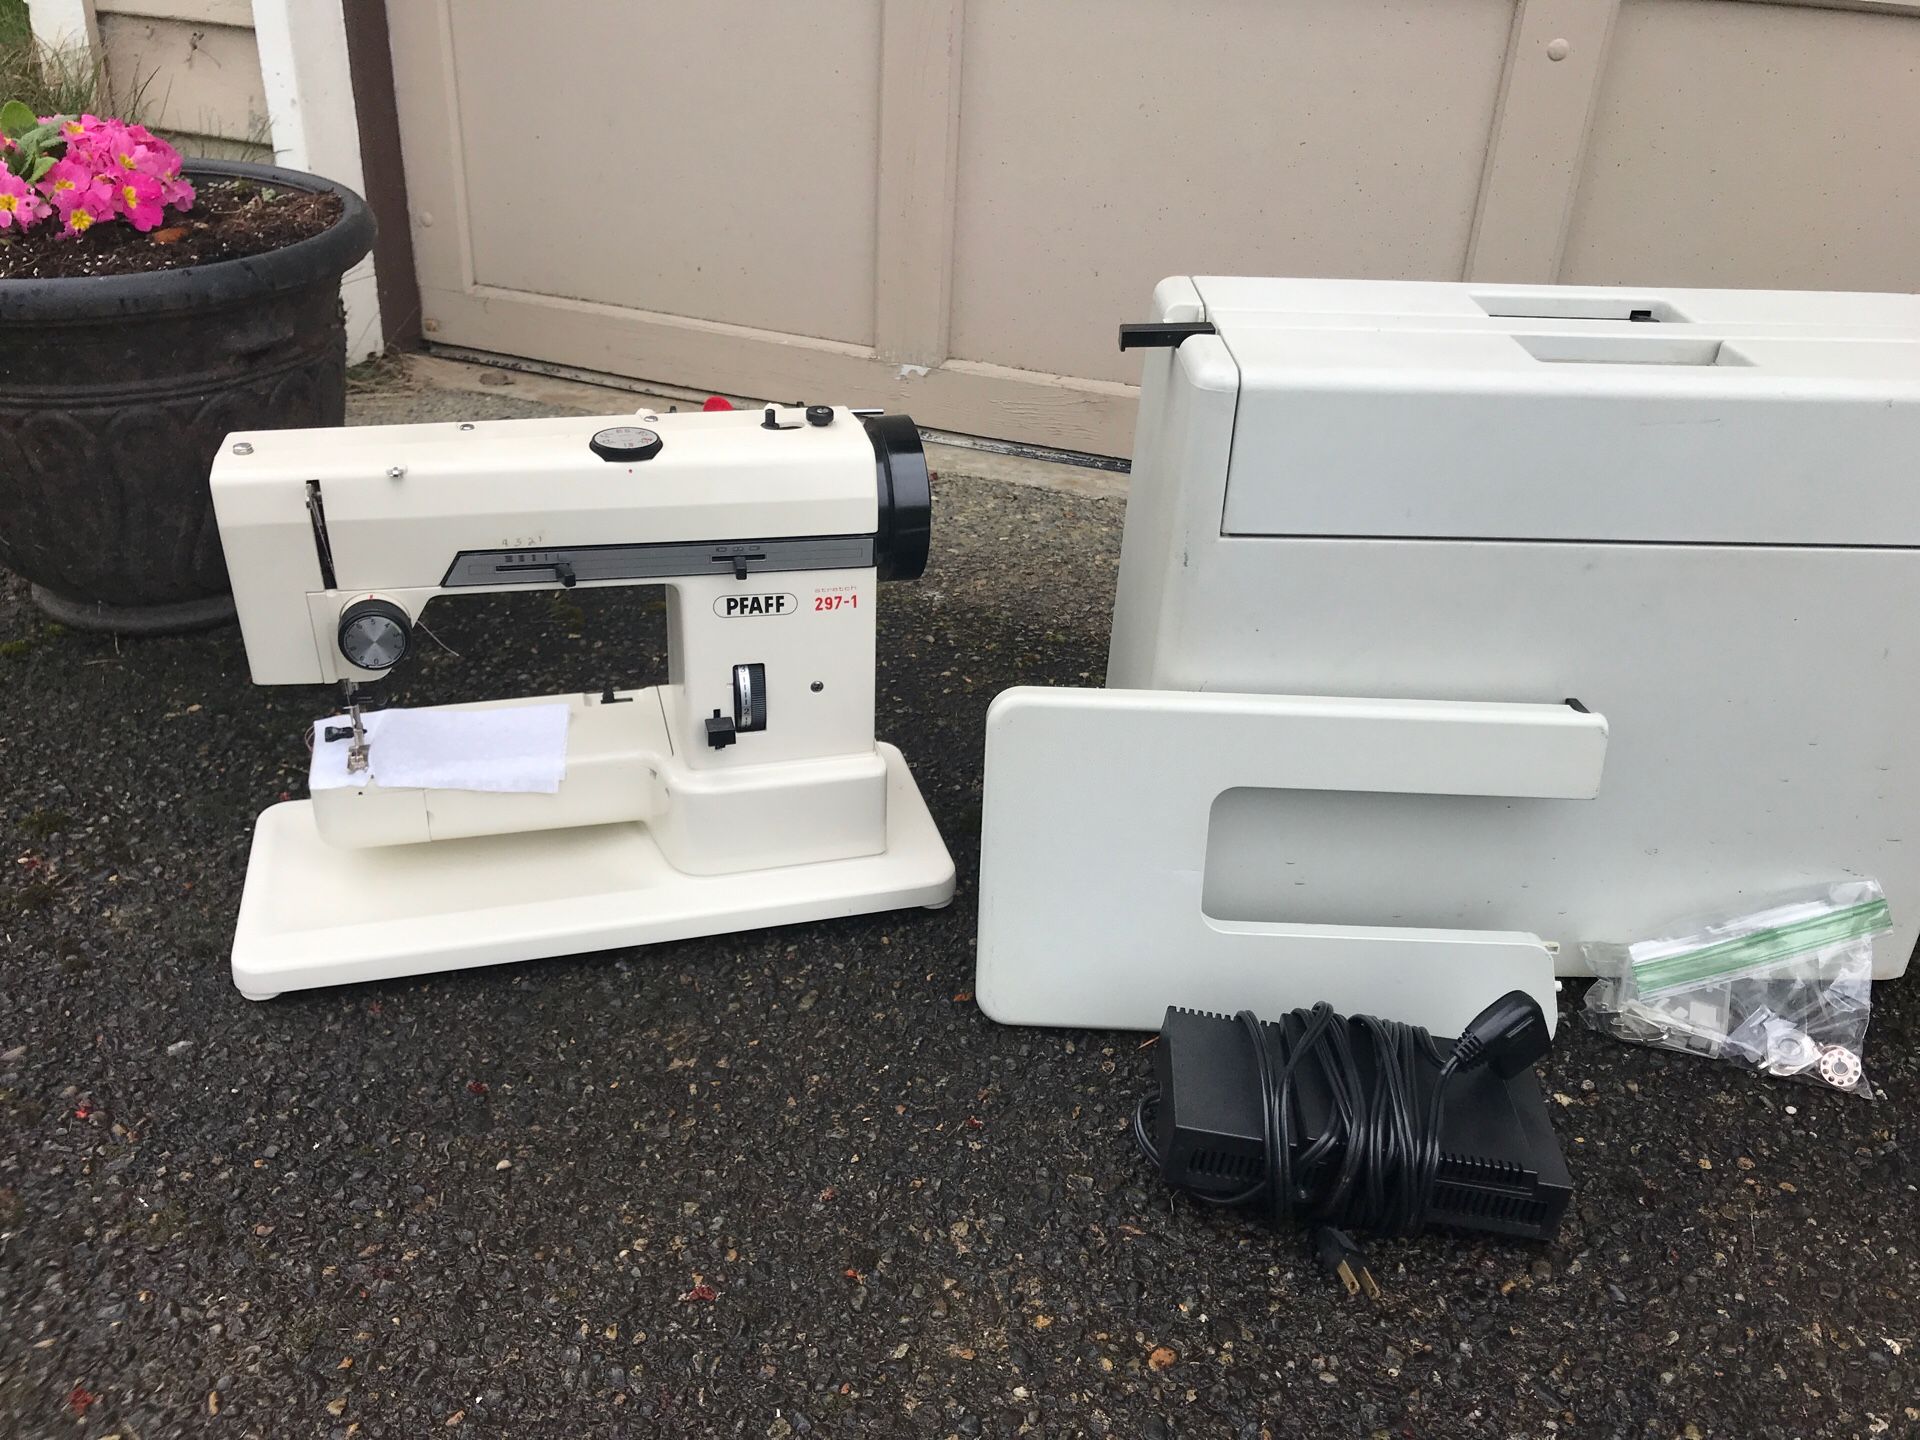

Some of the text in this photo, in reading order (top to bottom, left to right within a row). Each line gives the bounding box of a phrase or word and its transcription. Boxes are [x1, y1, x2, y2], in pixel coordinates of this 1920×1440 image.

[814, 585, 858, 593] stretch
[726, 595, 785, 616] PFAFF
[814, 595, 858, 612] 297-1
